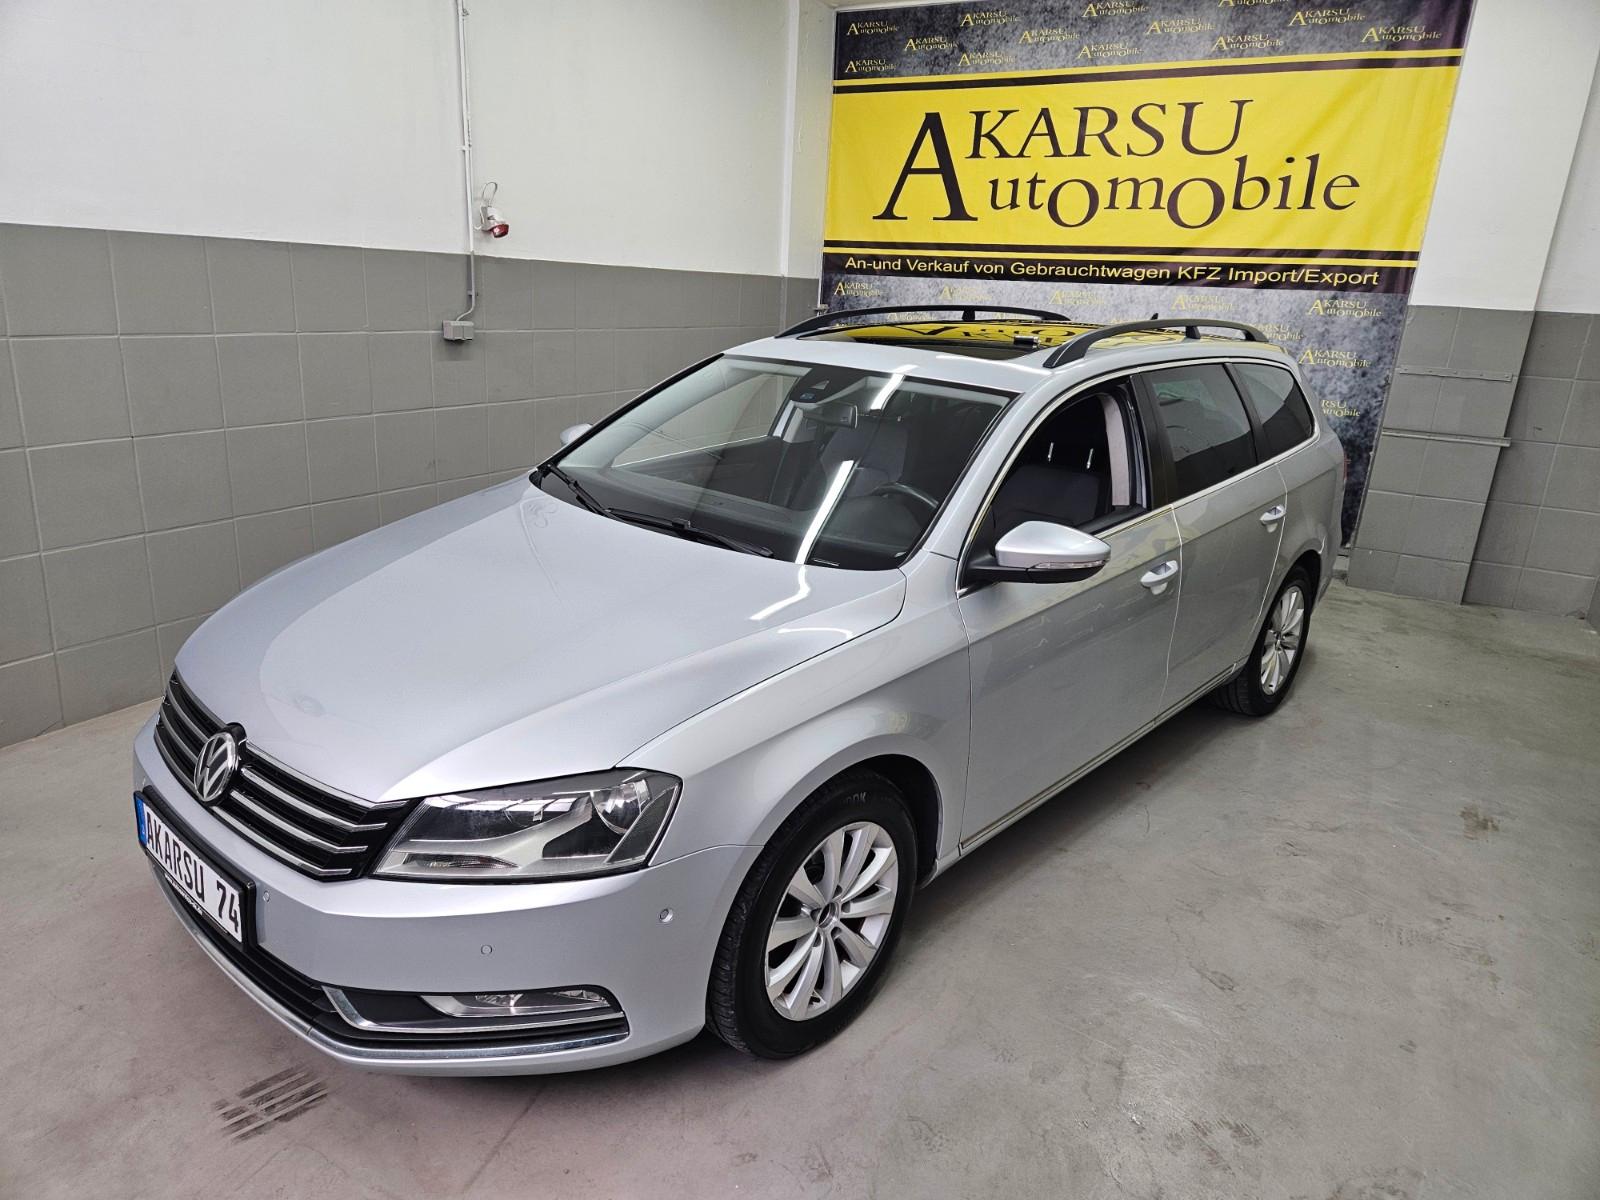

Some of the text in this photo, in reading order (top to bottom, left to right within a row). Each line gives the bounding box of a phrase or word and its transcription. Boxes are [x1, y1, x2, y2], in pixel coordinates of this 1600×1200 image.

[1081, 0, 1134, 17] AKARSU
[960, 10, 1007, 27] AKARSU
[1288, 8, 1349, 27] AKARSU
[847, 21, 888, 35] AKARSU
[1145, 18, 1201, 35] AKARSU
[1360, 25, 1425, 43] AKARSU
[904, 36, 946, 51] AKARSU
[1019, 28, 1066, 43] AKARSU
[1211, 34, 1269, 51] AKARSU
[958, 51, 1002, 66] AKARSU
[1076, 42, 1128, 59] AKARSU
[845, 59, 886, 73] AKARSU
[873, 99, 1254, 221] AKARSU
[845, 257, 1380, 287] An-und Verkauf von Gebrauchtwagen KFZ Import/Export
[1307, 299, 1367, 316] AKARSU
[1299, 349, 1357, 365] AKARSU
[1321, 399, 1347, 409] RSU
[147, 811, 205, 903] AKARSU
[216, 880, 239, 934] 74
